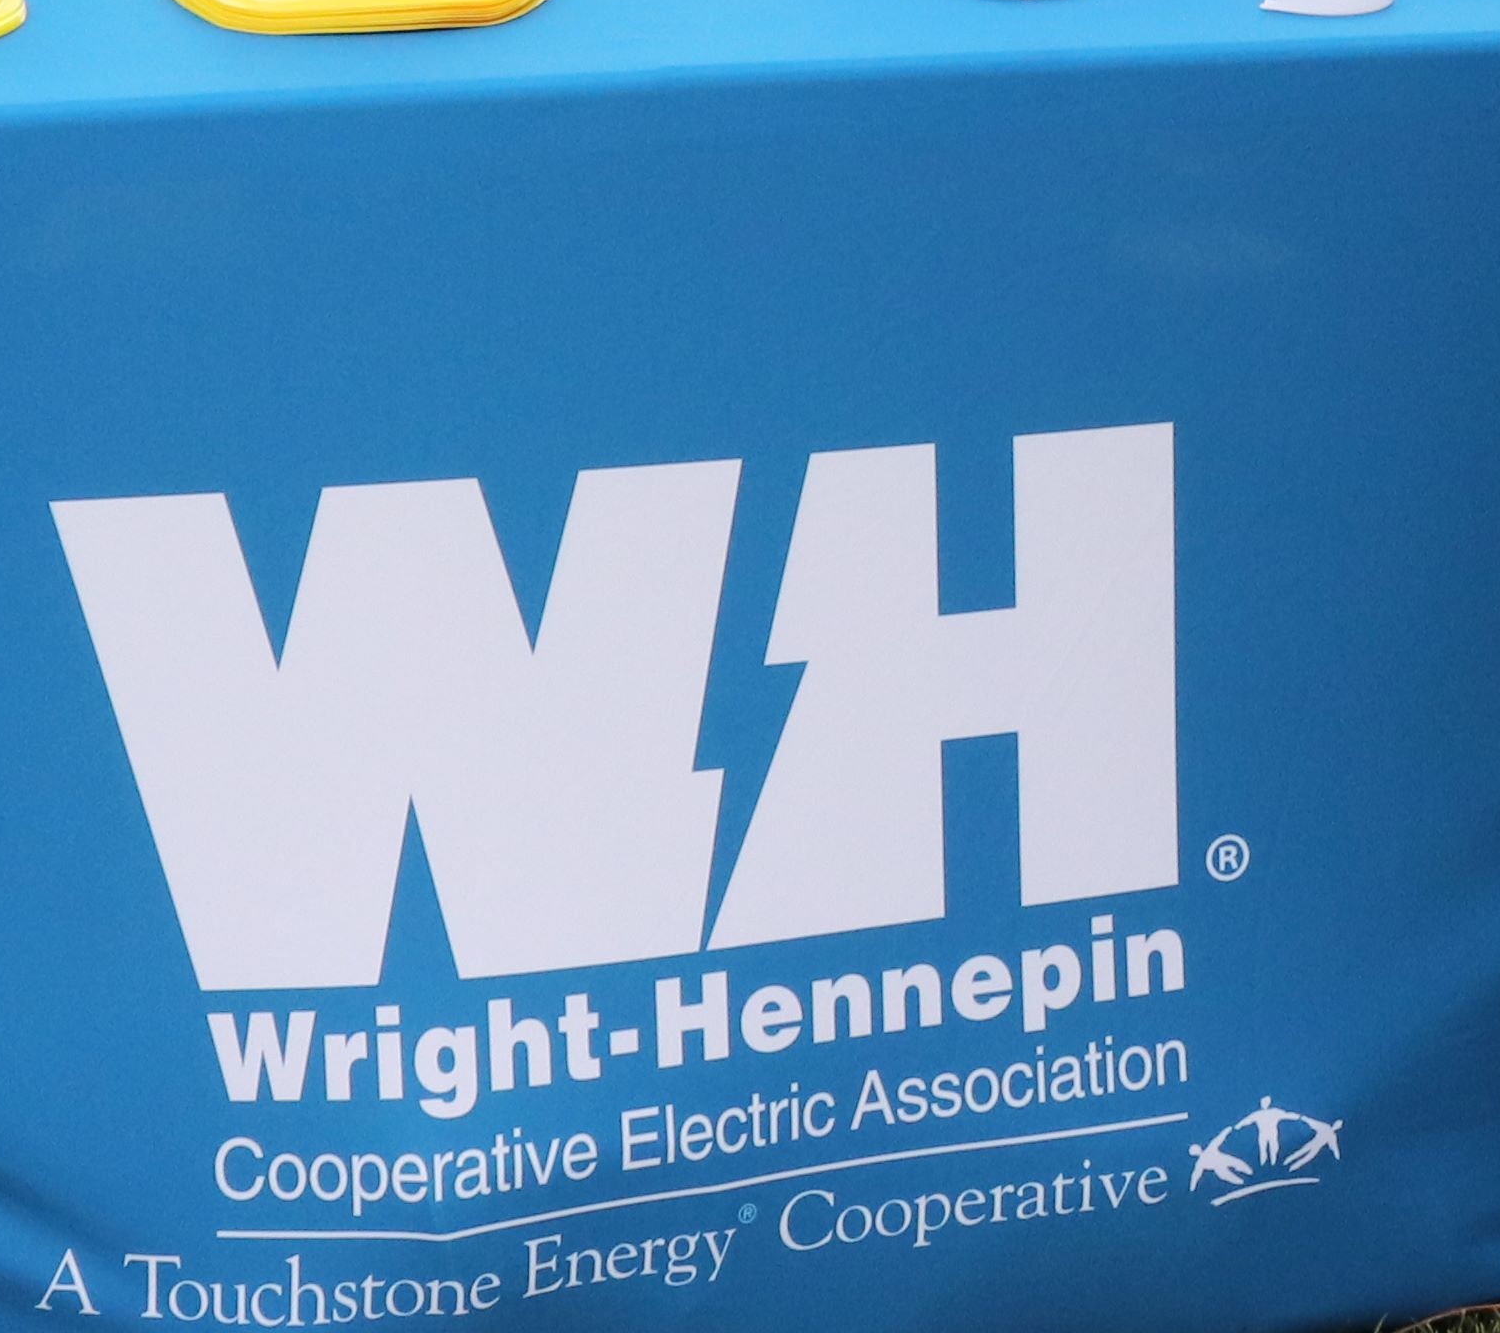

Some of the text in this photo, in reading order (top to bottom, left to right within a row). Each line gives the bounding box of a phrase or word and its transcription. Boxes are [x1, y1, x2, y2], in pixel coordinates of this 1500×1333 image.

[48, 421, 1179, 991] WH
[206, 914, 1185, 1119] Wright-Hennepin
[214, 1034, 1189, 1215] Cooperative Electric Association
[34, 1247, 100, 1317] A
[123, 1252, 501, 1330] Touchstone
[778, 1159, 1170, 1252] Cooperative
